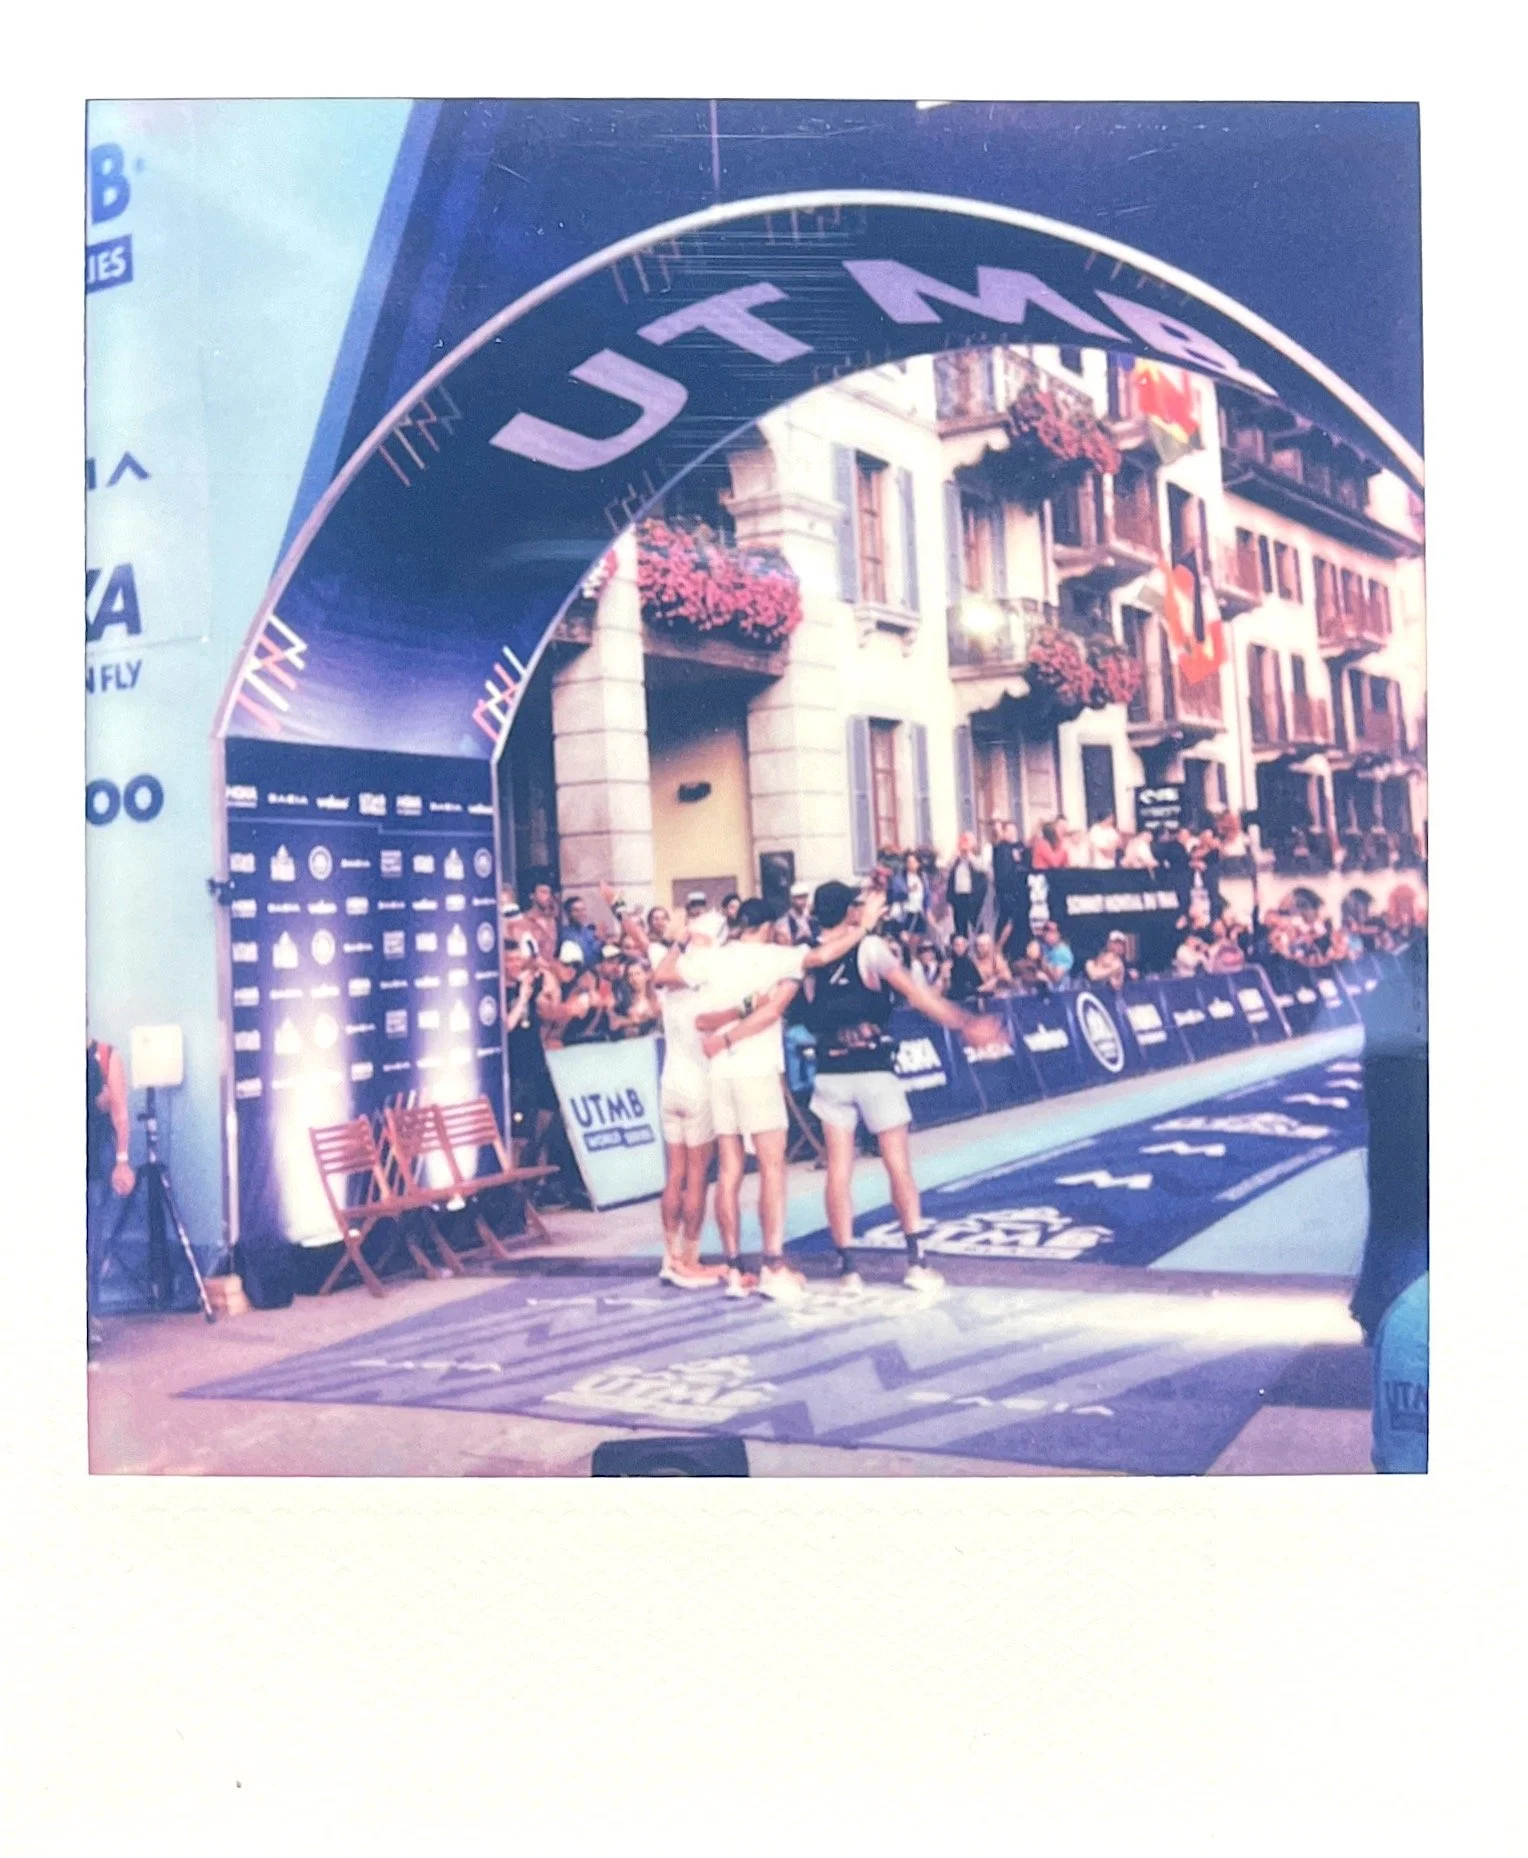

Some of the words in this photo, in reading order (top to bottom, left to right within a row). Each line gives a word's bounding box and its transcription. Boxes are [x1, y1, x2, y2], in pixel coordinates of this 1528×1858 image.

[489, 259, 1279, 472] UTMB
[101, 660, 142, 691] FLY
[569, 1087, 645, 1128] UTMB
